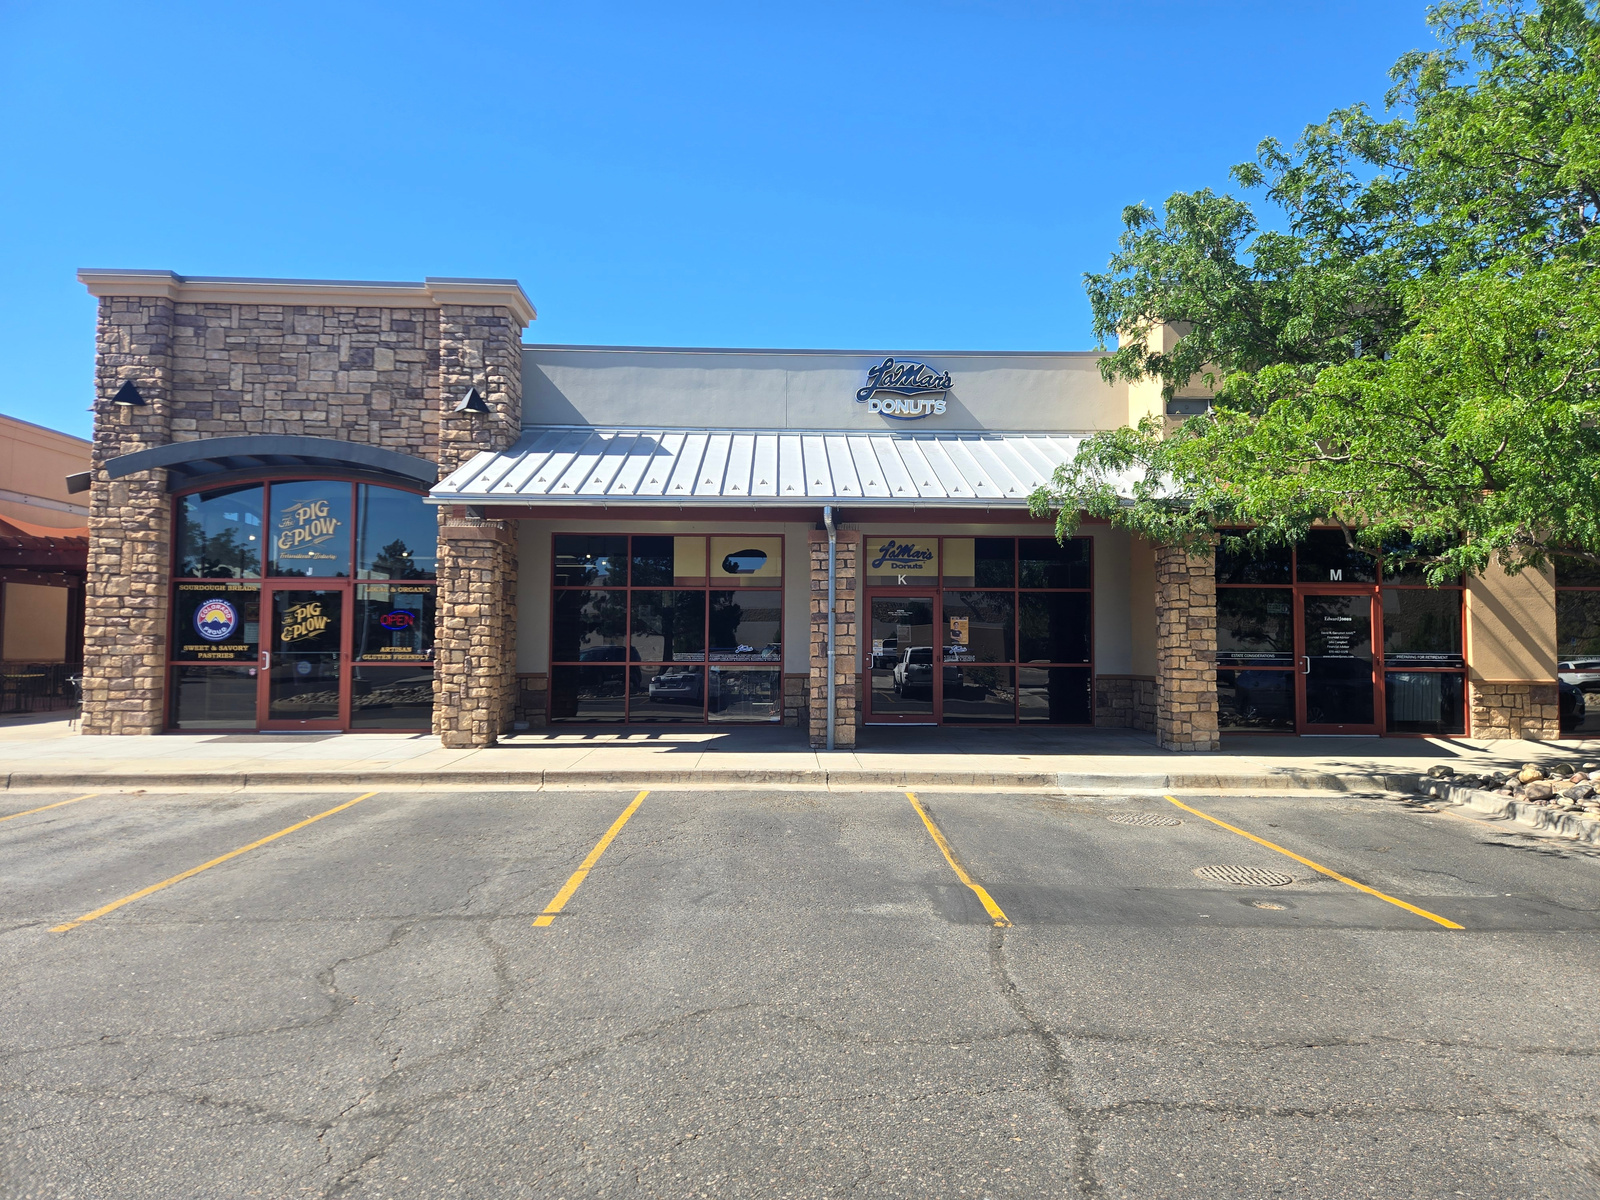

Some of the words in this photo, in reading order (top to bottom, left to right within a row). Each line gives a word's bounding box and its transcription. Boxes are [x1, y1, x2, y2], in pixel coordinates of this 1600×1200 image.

[855, 357, 954, 402] LaMar's
[867, 399, 947, 415] DONUTS
[295, 500, 331, 526] PIG
[291, 518, 342, 546] PLOW
[872, 540, 933, 568] LaMar's
[897, 574, 907, 585] K
[1329, 569, 1342, 581] M
[200, 604, 232, 618] COLORADO
[294, 602, 323, 623] PIG
[380, 614, 414, 626] OPEN
[203, 626, 227, 635] PROUD
[292, 616, 332, 639] PLOW
